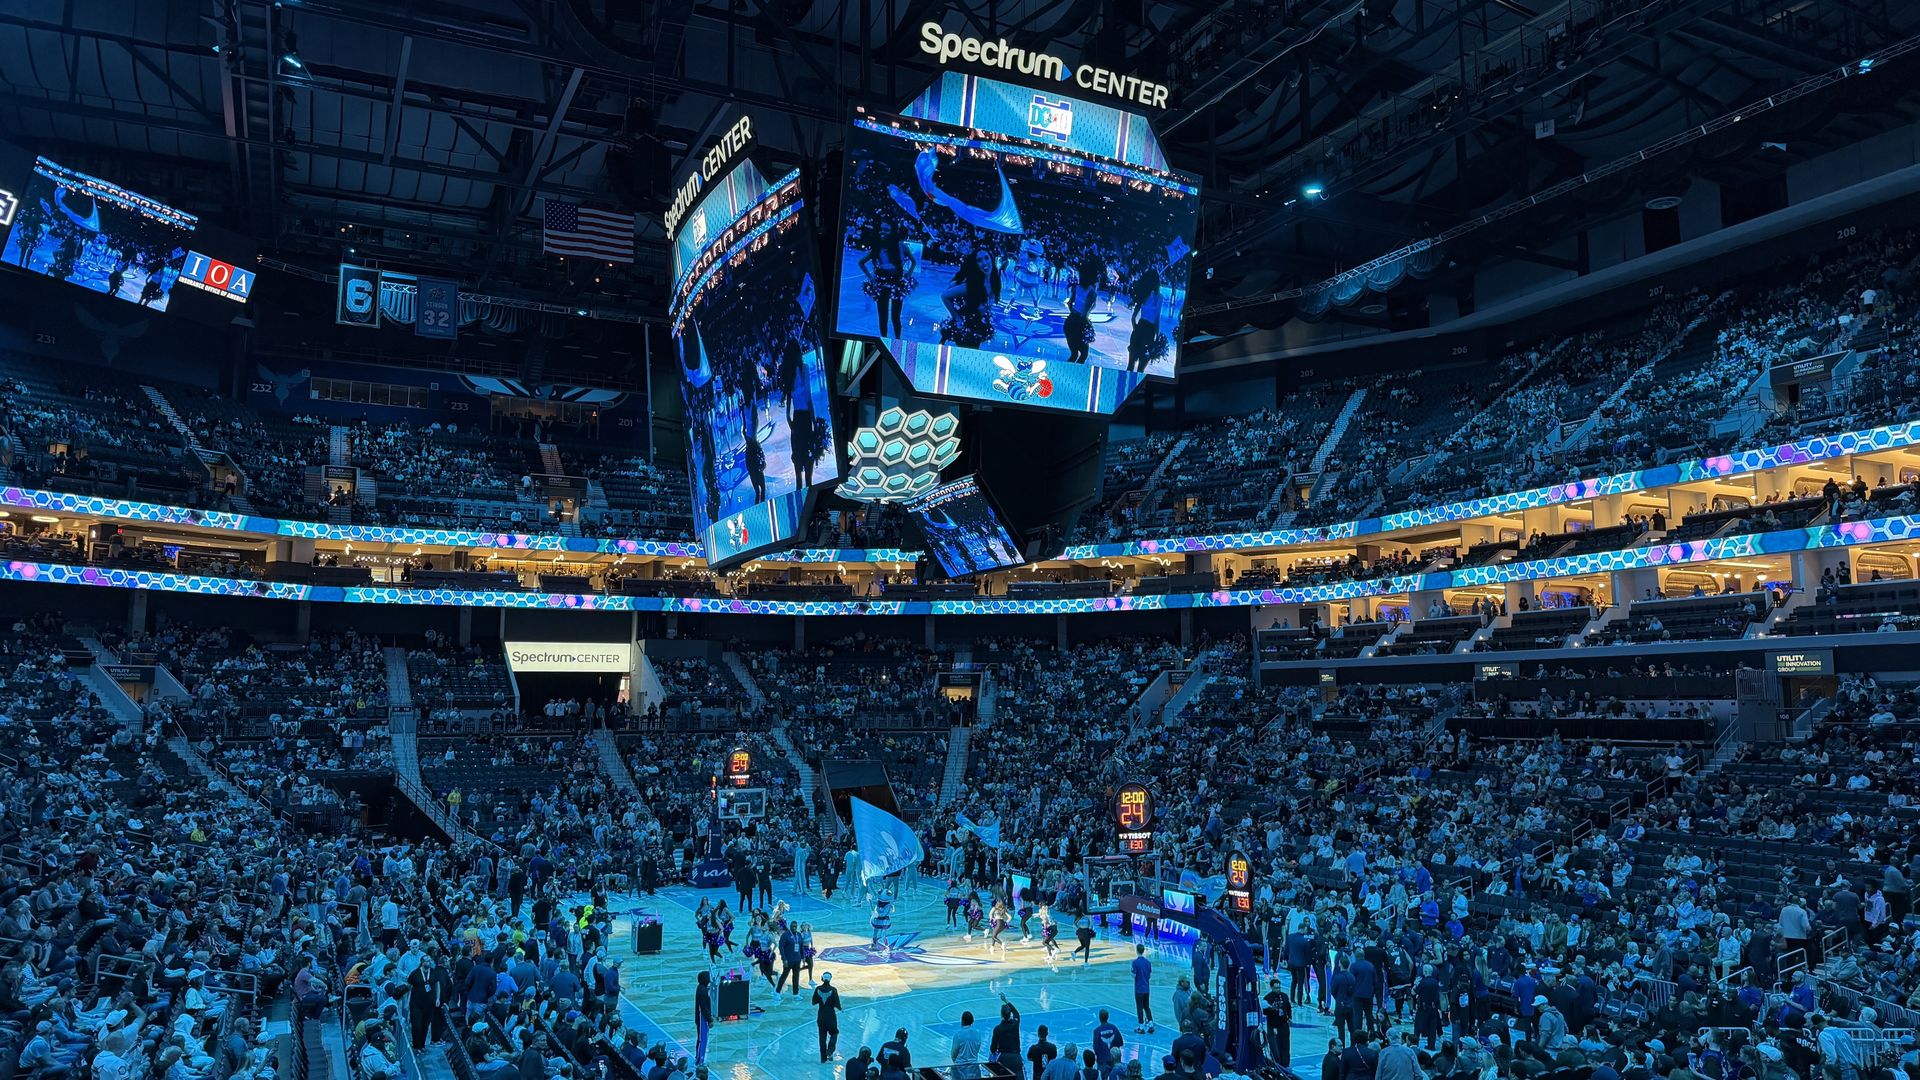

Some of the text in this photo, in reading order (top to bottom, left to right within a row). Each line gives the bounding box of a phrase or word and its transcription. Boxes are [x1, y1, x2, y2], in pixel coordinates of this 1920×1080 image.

[920, 22, 1169, 109] Spectrum CENTER
[664, 115, 752, 241] Spectrum CENTER
[1836, 226, 1857, 239] 208
[346, 278, 373, 313] 6
[1649, 285, 1664, 297] 207
[226, 292, 247, 304] AMERICA
[423, 309, 450, 327] 32
[36, 333, 56, 345] 231
[1452, 346, 1468, 355] 206
[1793, 362, 1813, 370] UTILITY
[252, 383, 272, 393] 232
[451, 402, 469, 411] 233
[618, 417, 633, 427] 201
[512, 651, 620, 664] Spectrum CENTER
[1776, 654, 1805, 662] UTILITY
[732, 760, 747, 772] 24
[1122, 791, 1145, 804] 12:00
[1121, 804, 1144, 825] 24
[1128, 832, 1151, 840] TISSOT
[1231, 860, 1247, 871] 12:00
[1232, 871, 1245, 884] 24
[1394, 956, 1401, 966] 4
[1218, 975, 1227, 1031] bet365
